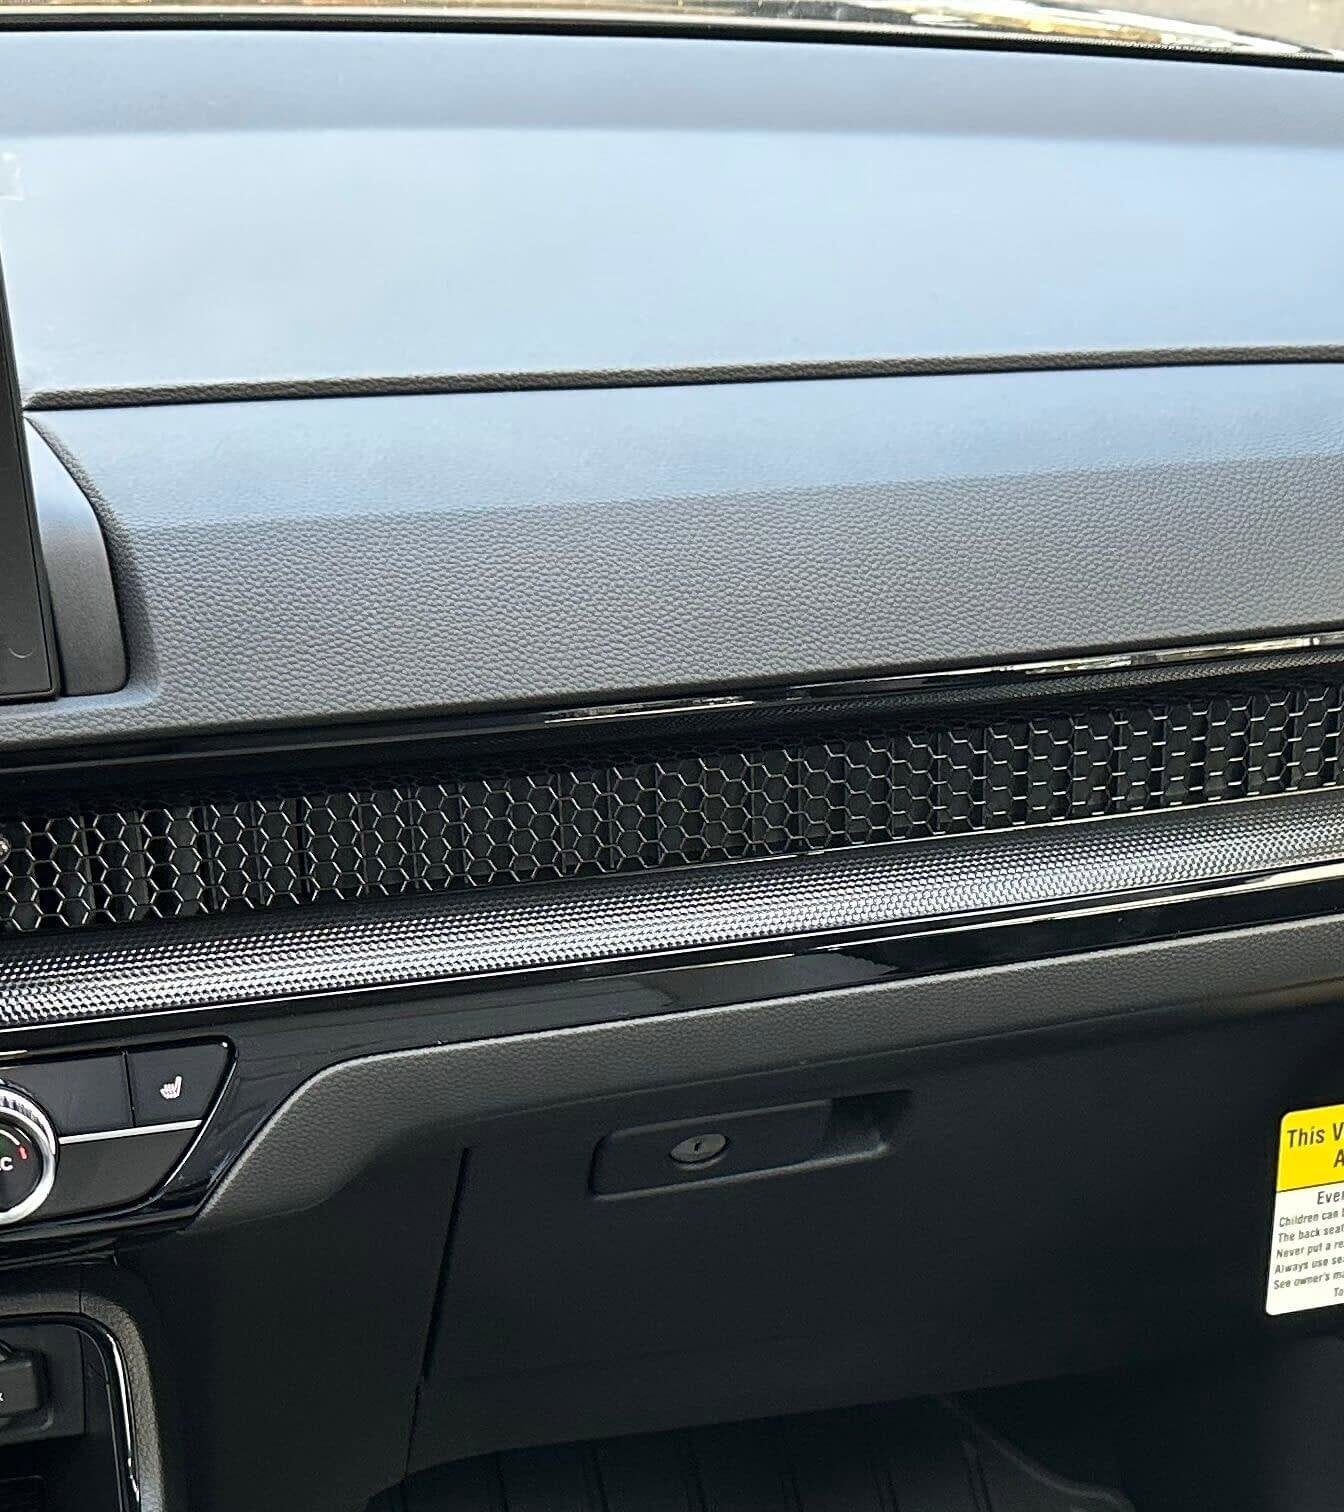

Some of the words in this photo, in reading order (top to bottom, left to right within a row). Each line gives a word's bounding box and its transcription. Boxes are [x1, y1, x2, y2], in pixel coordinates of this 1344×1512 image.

[1287, 1125, 1325, 1149] This
[1279, 1212, 1319, 1227] Children
[1322, 1210, 1338, 1221] can
[1278, 1232, 1295, 1243] The
[1298, 1227, 1320, 1240] back
[1324, 1223, 1344, 1236] seat
[1276, 1246, 1305, 1259] Never
[1307, 1243, 1323, 1256] put
[1325, 1242, 1331, 1251] a
[1275, 1261, 1309, 1274] Always
[1311, 1258, 1329, 1269] use
[1274, 1279, 1291, 1290] See
[1334, 1287, 1344, 1297] To
